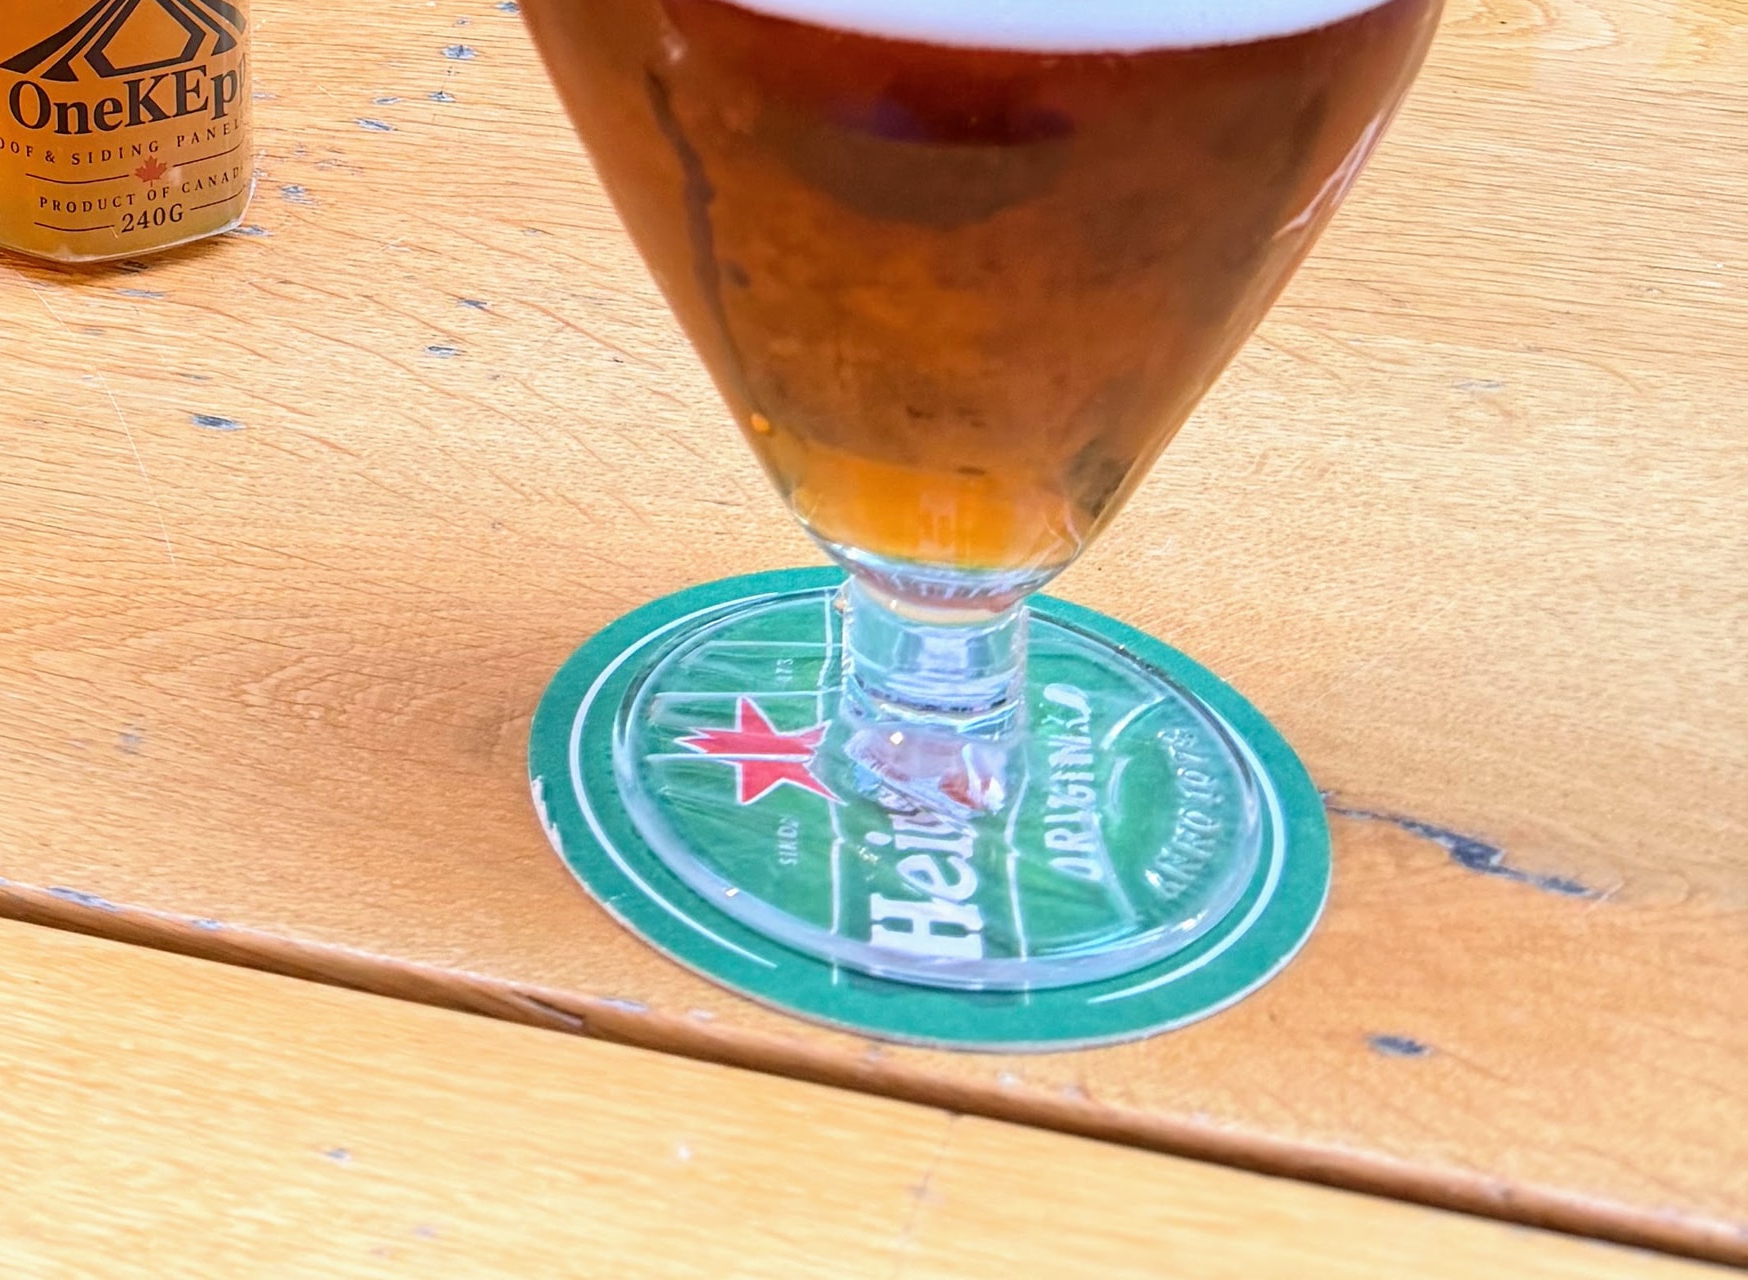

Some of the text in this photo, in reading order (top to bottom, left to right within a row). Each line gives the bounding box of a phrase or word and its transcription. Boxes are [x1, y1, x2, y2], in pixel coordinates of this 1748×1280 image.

[44, 150, 56, 164] &
[71, 140, 159, 166] SIDING
[176, 118, 243, 148] PANEL
[39, 165, 244, 214] PRODUCT OF CANAD
[121, 203, 185, 234] 240G
